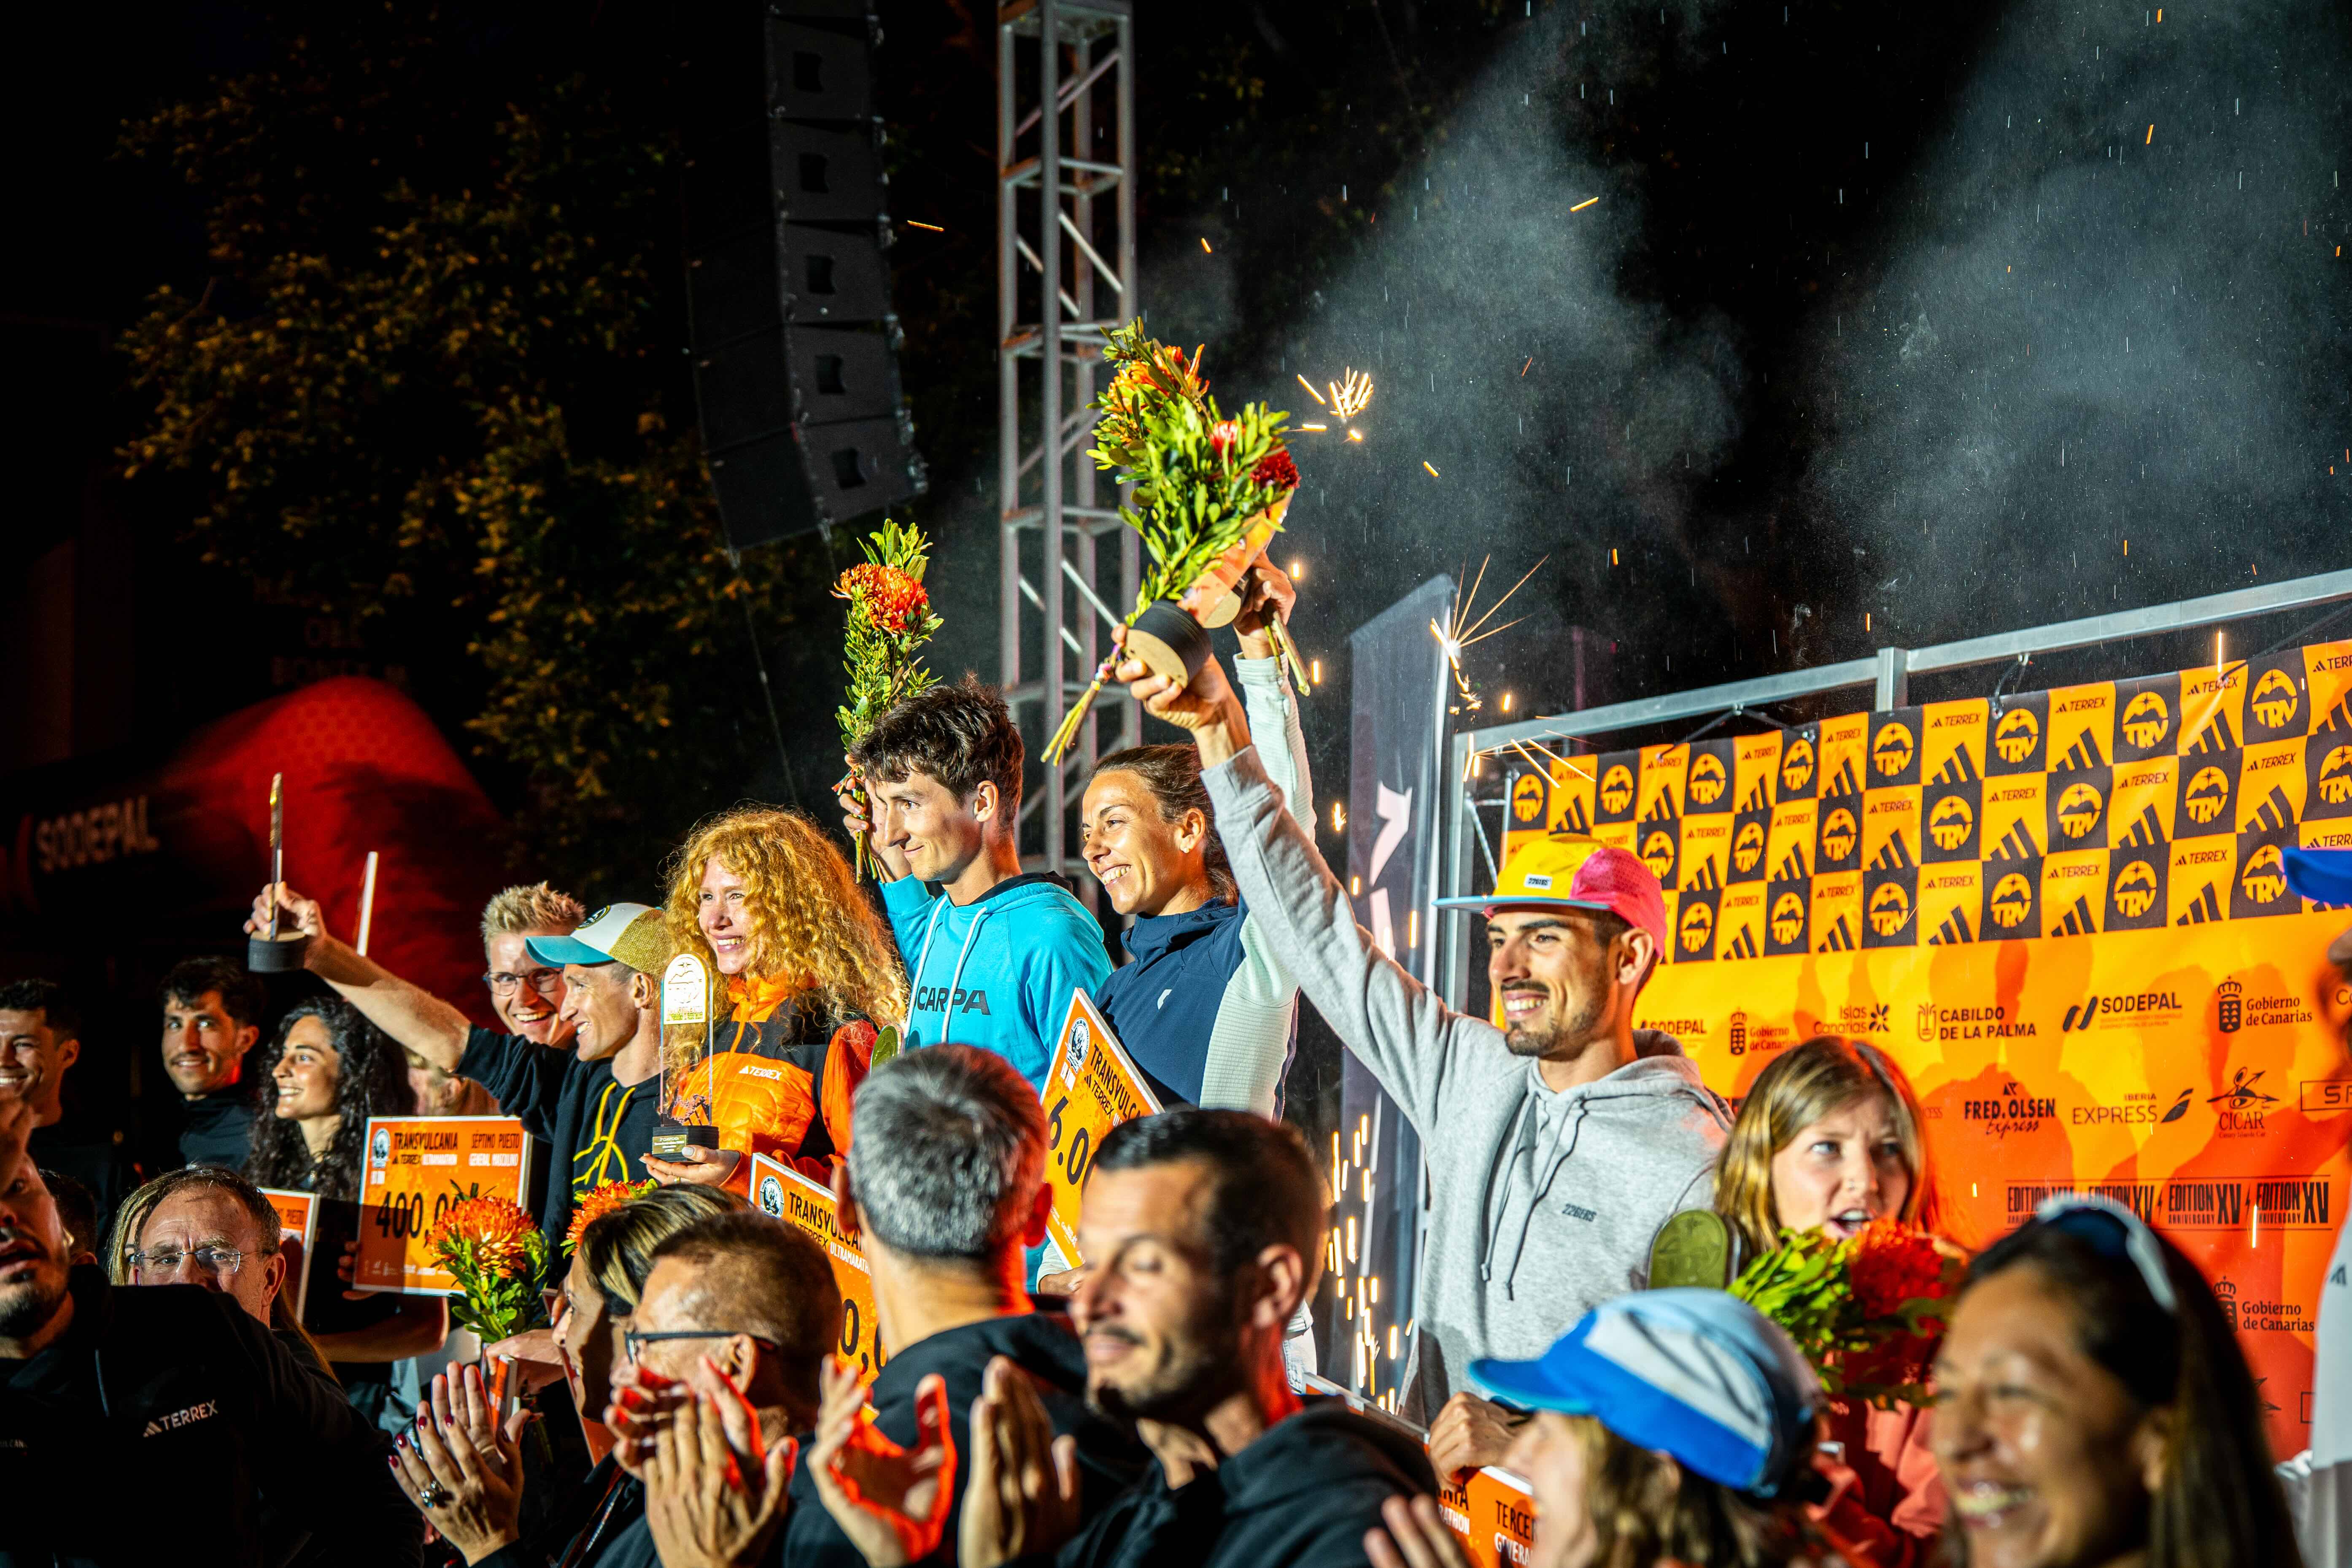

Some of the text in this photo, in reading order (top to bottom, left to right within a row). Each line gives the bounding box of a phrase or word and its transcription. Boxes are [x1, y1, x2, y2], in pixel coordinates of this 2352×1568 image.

[2070, 697, 2106, 711] TERREX
[1945, 713, 1981, 726] TERREX
[2252, 697, 2298, 729] TRV
[1836, 728, 1862, 741] TERREX
[2122, 719, 2169, 749] TRV
[1754, 746, 1776, 759] TERREX
[1995, 735, 2038, 763] TRV
[2260, 752, 2297, 769] TERREX
[2130, 772, 2169, 788] TERREX
[2002, 787, 2037, 801] TERREX
[1880, 800, 1913, 813] TERREX
[2185, 794, 2228, 824] TRV
[1784, 813, 1811, 826] TERREX
[2058, 810, 2101, 839] TRV
[1696, 827, 1727, 838] TERREX
[1930, 823, 1972, 851] TRV
[2189, 850, 2228, 864] TERREX
[2061, 864, 2101, 878] TERREX
[1938, 875, 1975, 888] TERREX
[1826, 885, 1856, 898] TERREX
[1734, 896, 1760, 907] TERREX
[2114, 889, 2157, 918] TRV
[1991, 900, 2031, 928] TRV
[917, 986, 992, 1016] CARPA
[2101, 992, 2182, 1014] SODEPAL
[2246, 996, 2301, 1011] Gobierno
[1839, 1004, 1867, 1020] Islas
[1940, 1006, 2005, 1023] CABILDO
[2246, 1010, 2313, 1026] de Canarias
[1750, 1026, 1789, 1038] Gobierno
[1814, 1020, 1867, 1034] Canarias
[1940, 1023, 2036, 1040] DE LA PALMA
[1750, 1040, 1759, 1050] de
[749, 1066, 782, 1082] TERREX
[1091, 1080, 1114, 1120] TERREX
[2124, 1093, 2157, 1101] IBERIA
[2073, 1104, 2158, 1125] EXPRESS
[2219, 1111, 2265, 1131] CICAR
[394, 1132, 458, 1150] TRANSVULCANIA
[499, 1133, 520, 1149] PUESTO
[401, 1154, 421, 1165] TERREX
[2169, 1183, 2214, 1212] EDITION
[2216, 1183, 2242, 1225] XV
[2257, 1182, 2301, 1211] EDITION
[2302, 1181, 2329, 1224] XV
[2168, 1214, 2215, 1225] ANNIVERSARY
[2256, 1212, 2301, 1224] NNIVERSARY
[2242, 1301, 2302, 1316] Gobierno
[2243, 1317, 2315, 1332] de Canarias
[158, 1399, 218, 1431] TERREX
